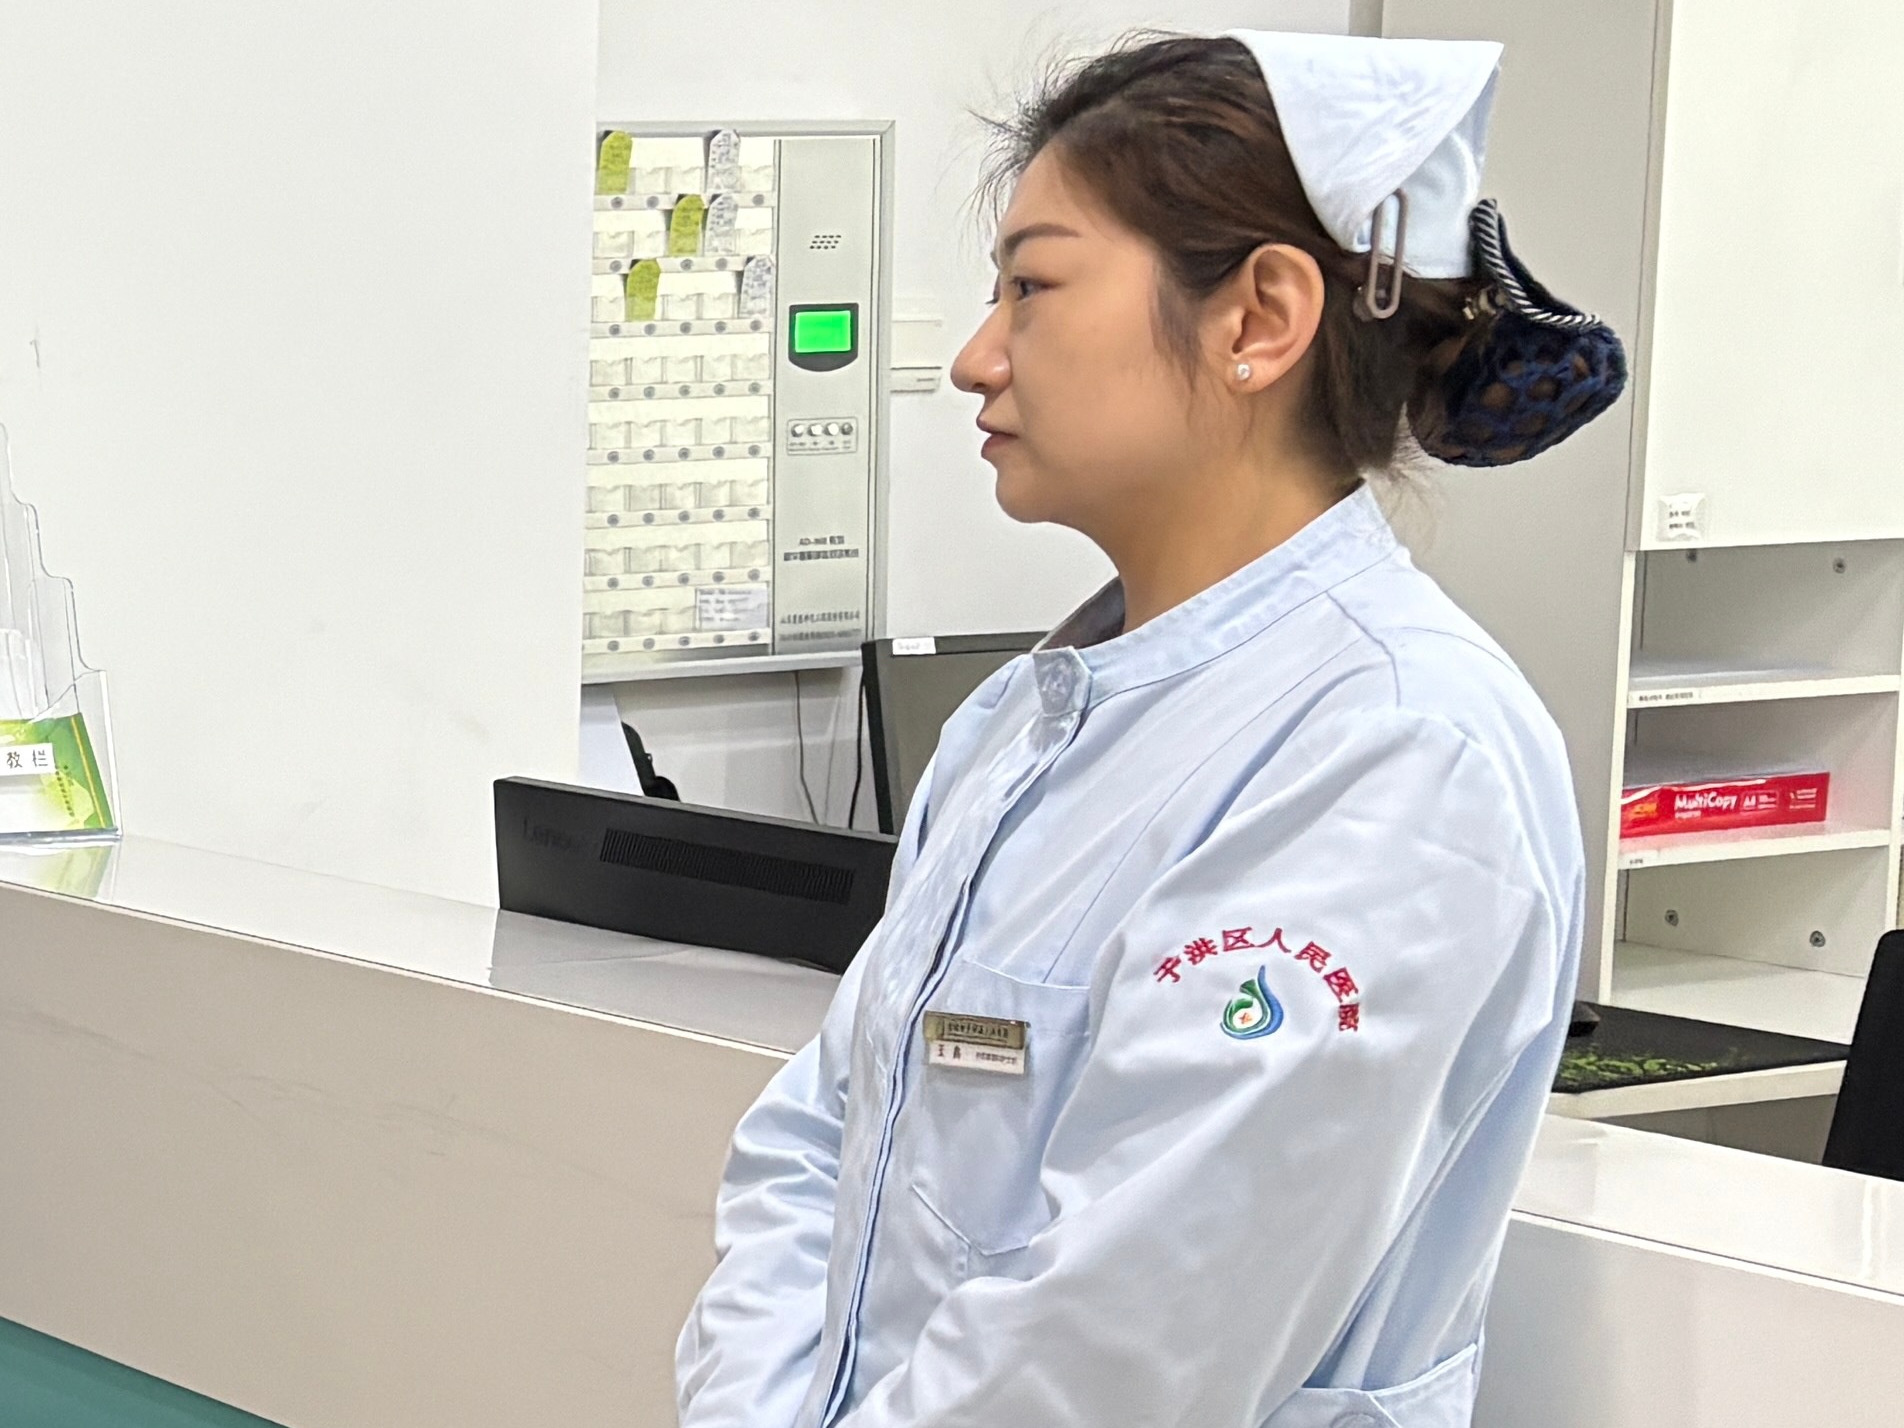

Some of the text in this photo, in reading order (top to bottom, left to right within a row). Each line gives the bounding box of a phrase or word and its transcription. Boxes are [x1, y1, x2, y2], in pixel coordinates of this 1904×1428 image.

[1674, 791, 1737, 810] MultiCopy
[1153, 926, 1360, 1032] 于洪区人民医院
